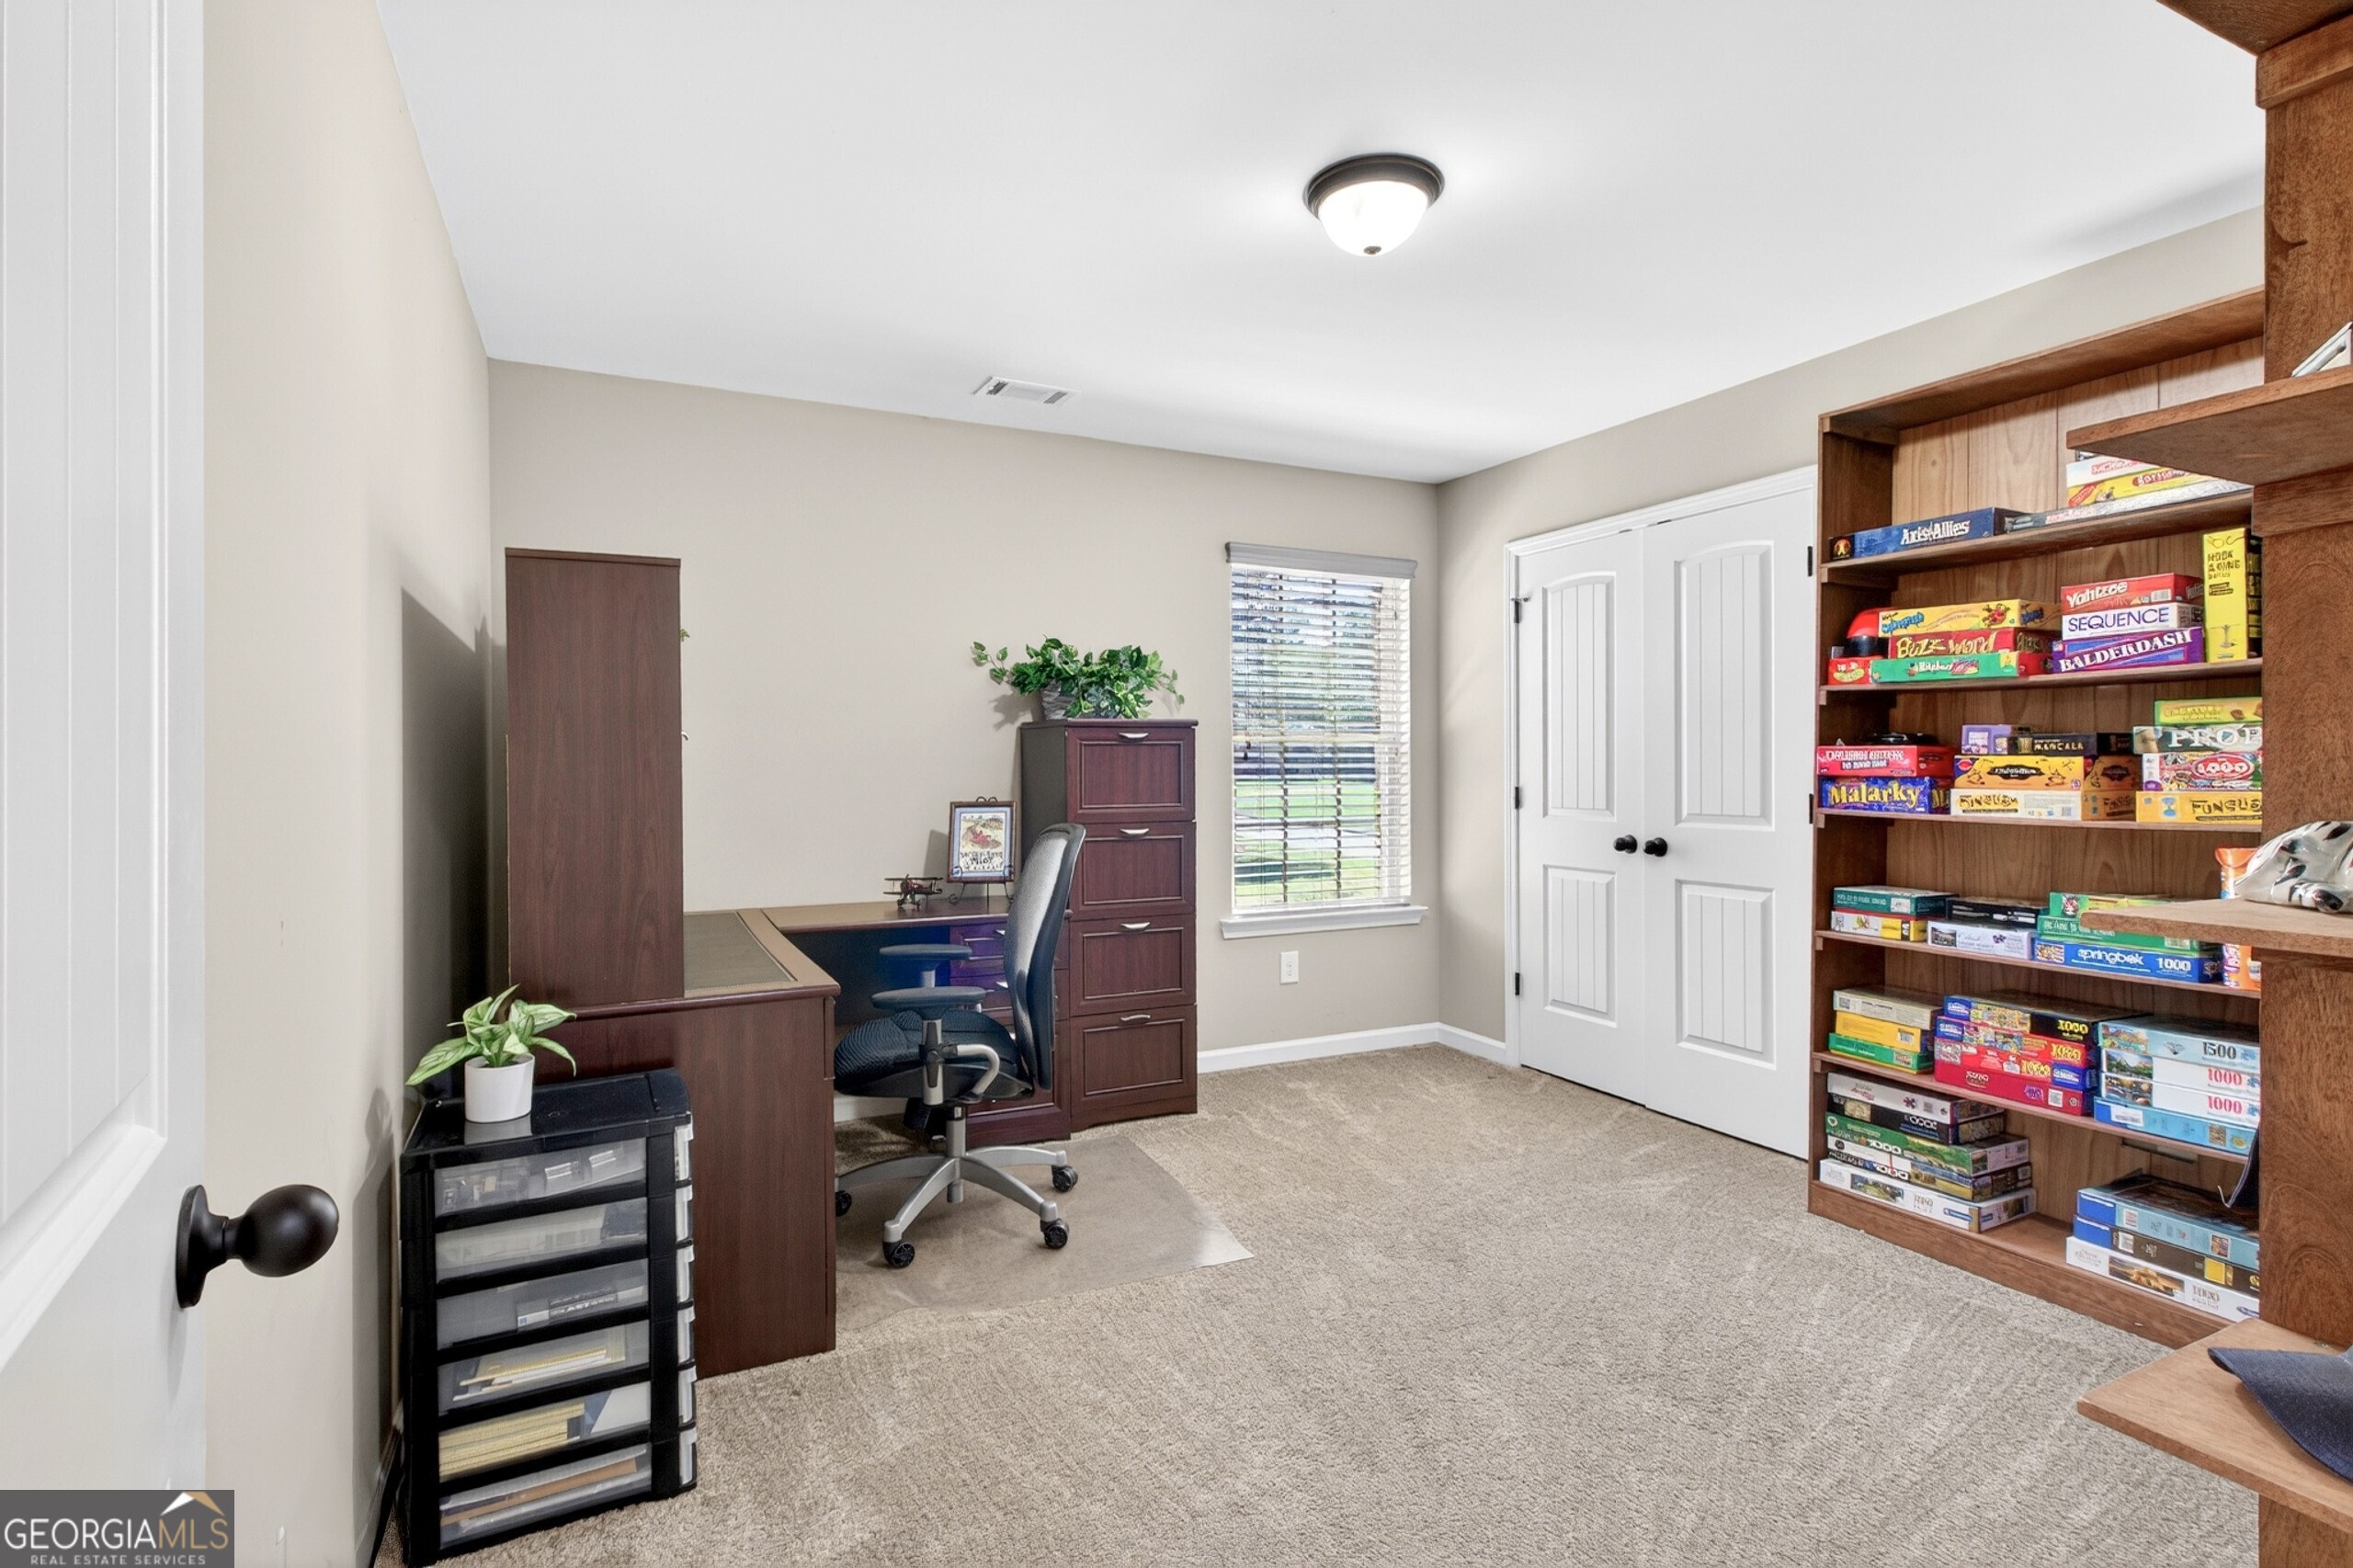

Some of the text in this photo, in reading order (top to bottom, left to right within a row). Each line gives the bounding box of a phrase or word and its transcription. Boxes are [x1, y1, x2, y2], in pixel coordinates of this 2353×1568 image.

[2068, 607, 2170, 632] SEQUENCE
[2058, 629, 2193, 673] BALDERDASH
[1830, 781, 1921, 809] Malarky
[2156, 958, 2191, 971] 1000
[2202, 1041, 2237, 1060] 1500
[2207, 1067, 2243, 1086] 1000
[2207, 1095, 2243, 1115] 1000
